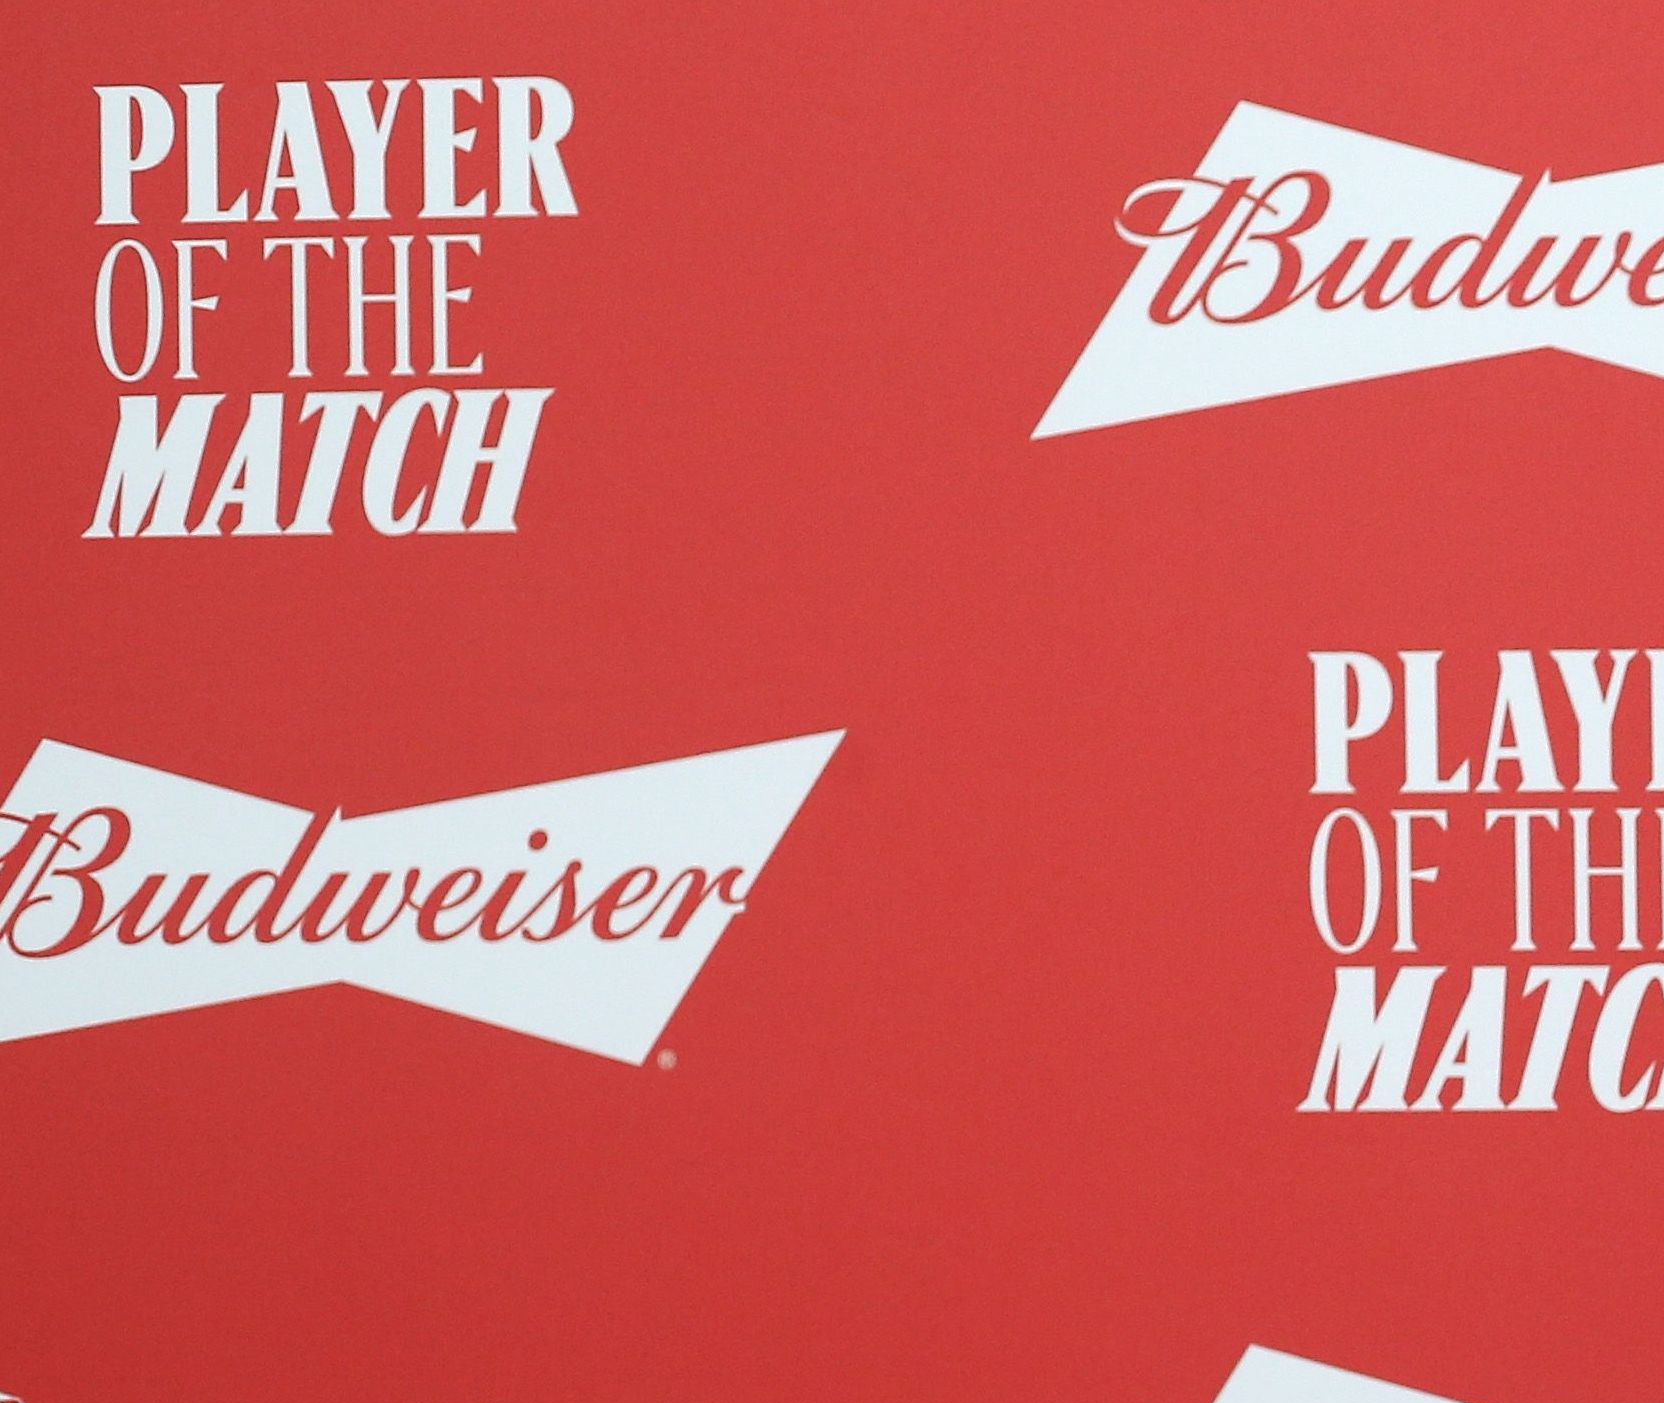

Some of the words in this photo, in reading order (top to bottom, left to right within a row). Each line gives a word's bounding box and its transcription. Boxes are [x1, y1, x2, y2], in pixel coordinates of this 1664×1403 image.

[93, 76, 579, 225] PLAYER
[95, 239, 228, 382] OF
[264, 234, 484, 380] THE
[82, 388, 554, 538] MATCH
[0, 805, 747, 959] Budweiser
[1310, 807, 1449, 954] OF
